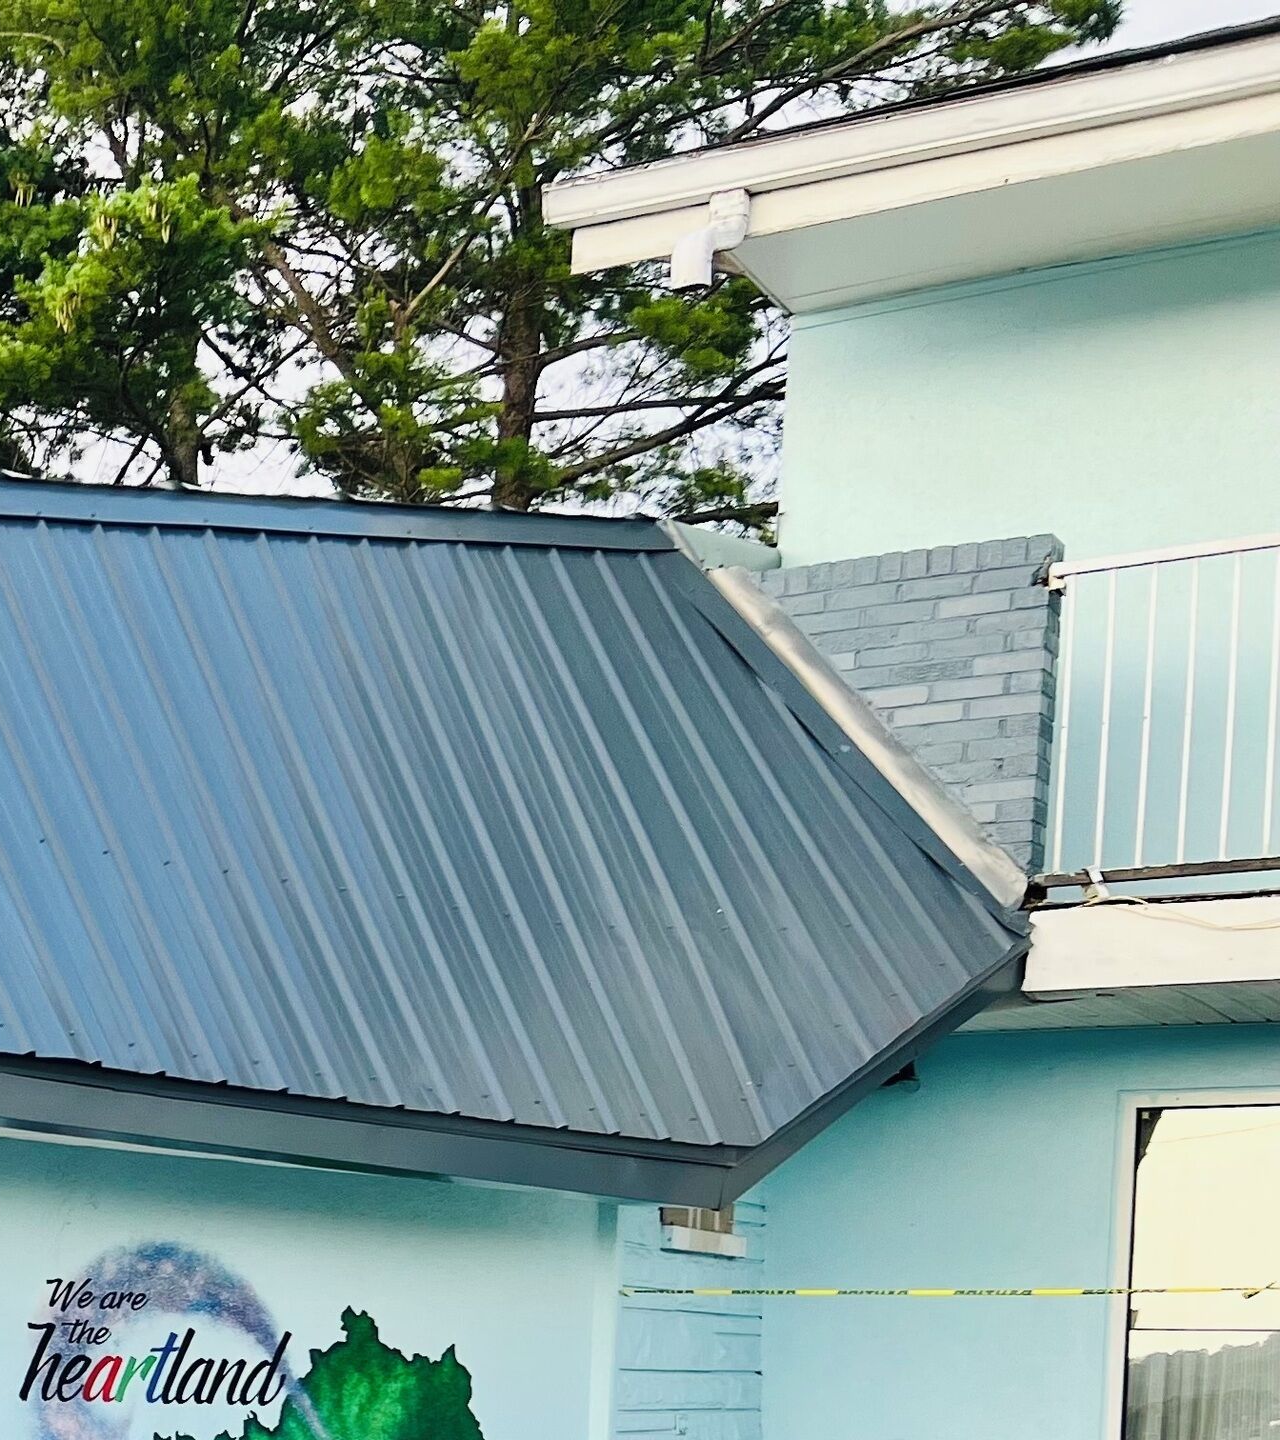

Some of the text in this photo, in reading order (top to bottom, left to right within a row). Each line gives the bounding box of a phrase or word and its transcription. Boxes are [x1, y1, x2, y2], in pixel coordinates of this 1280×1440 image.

[46, 1278, 151, 1312] We are
[61, 1319, 112, 1345] the
[19, 1322, 292, 1406] heartland
